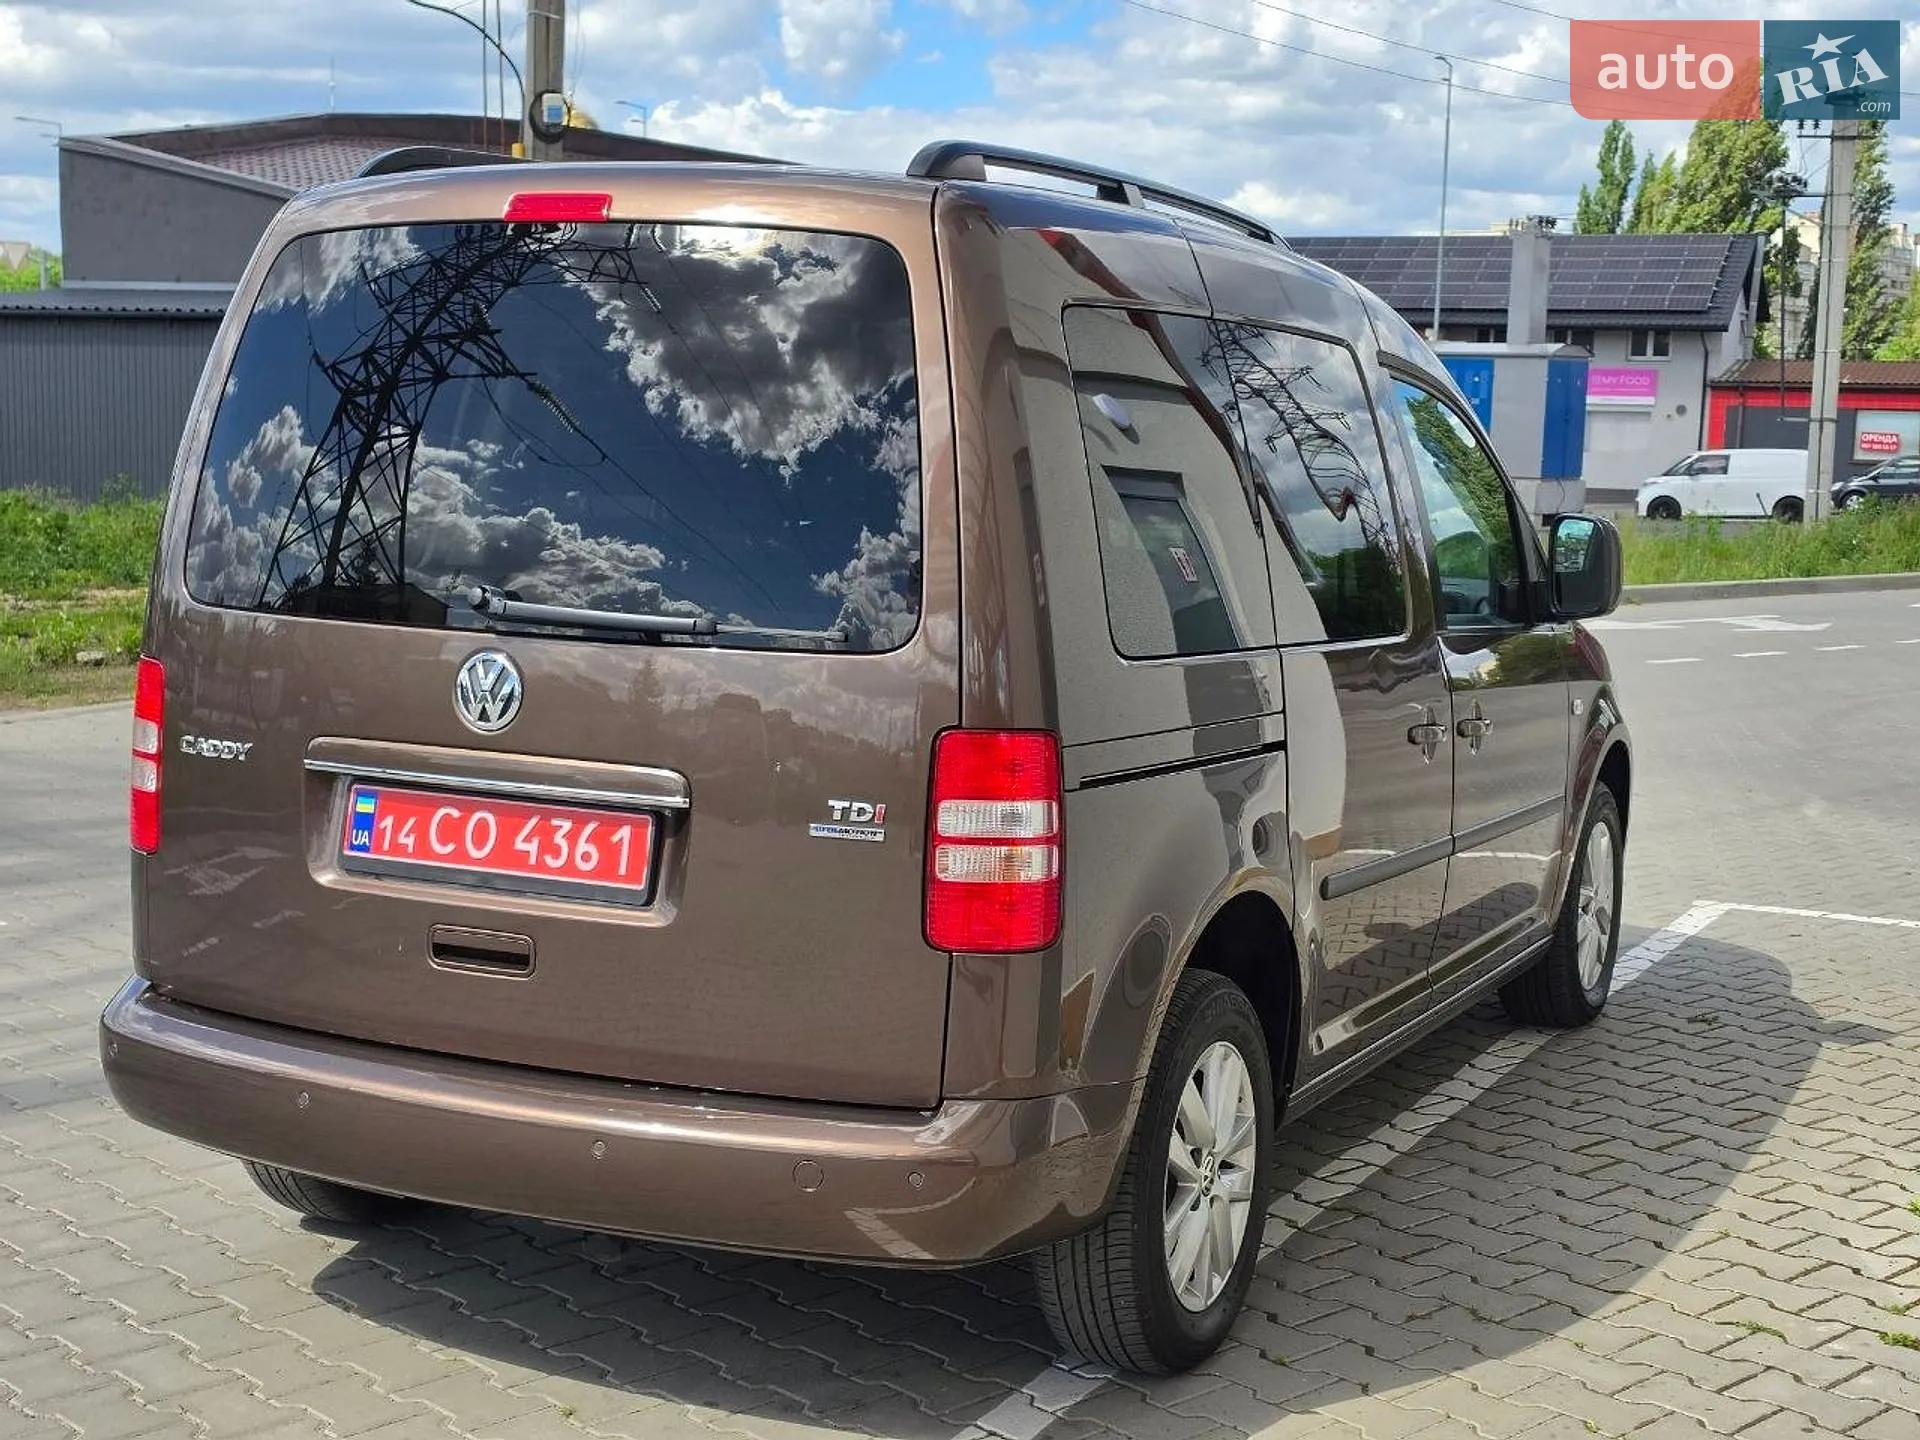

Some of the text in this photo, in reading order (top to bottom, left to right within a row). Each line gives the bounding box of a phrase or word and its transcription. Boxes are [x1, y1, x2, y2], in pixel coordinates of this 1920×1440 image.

[1861, 433, 1898, 443] ОРЕНДА
[180, 735, 253, 761] CADDY
[827, 799, 886, 824] TDI
[352, 829, 369, 847] UA
[378, 807, 632, 876] 14 CO 4361
